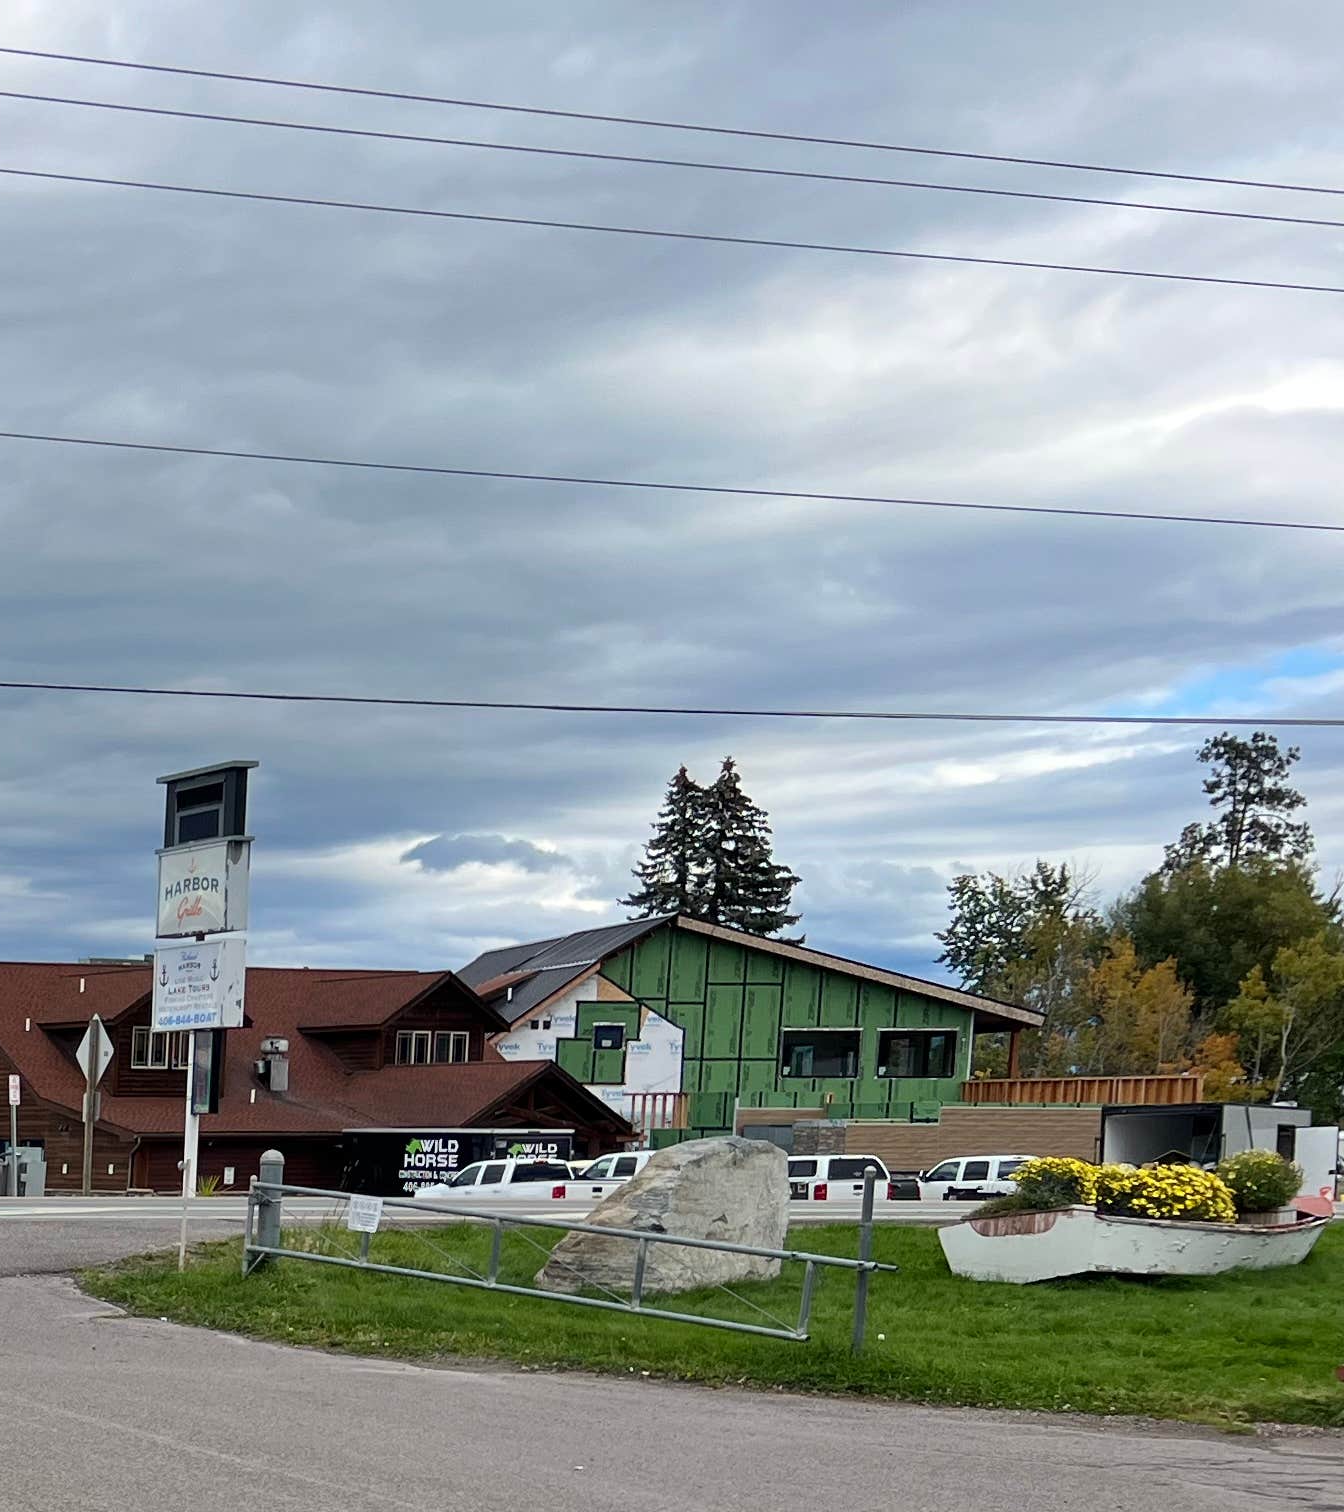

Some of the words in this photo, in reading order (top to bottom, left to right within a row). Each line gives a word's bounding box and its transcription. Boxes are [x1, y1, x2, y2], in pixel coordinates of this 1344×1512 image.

[165, 877, 219, 901] HARBOR
[177, 896, 203, 929] Grille
[188, 984, 210, 993] TOURS
[420, 1138, 459, 1153] WILD
[522, 1143, 558, 1154] WILD
[403, 1153, 459, 1168] HORSE
